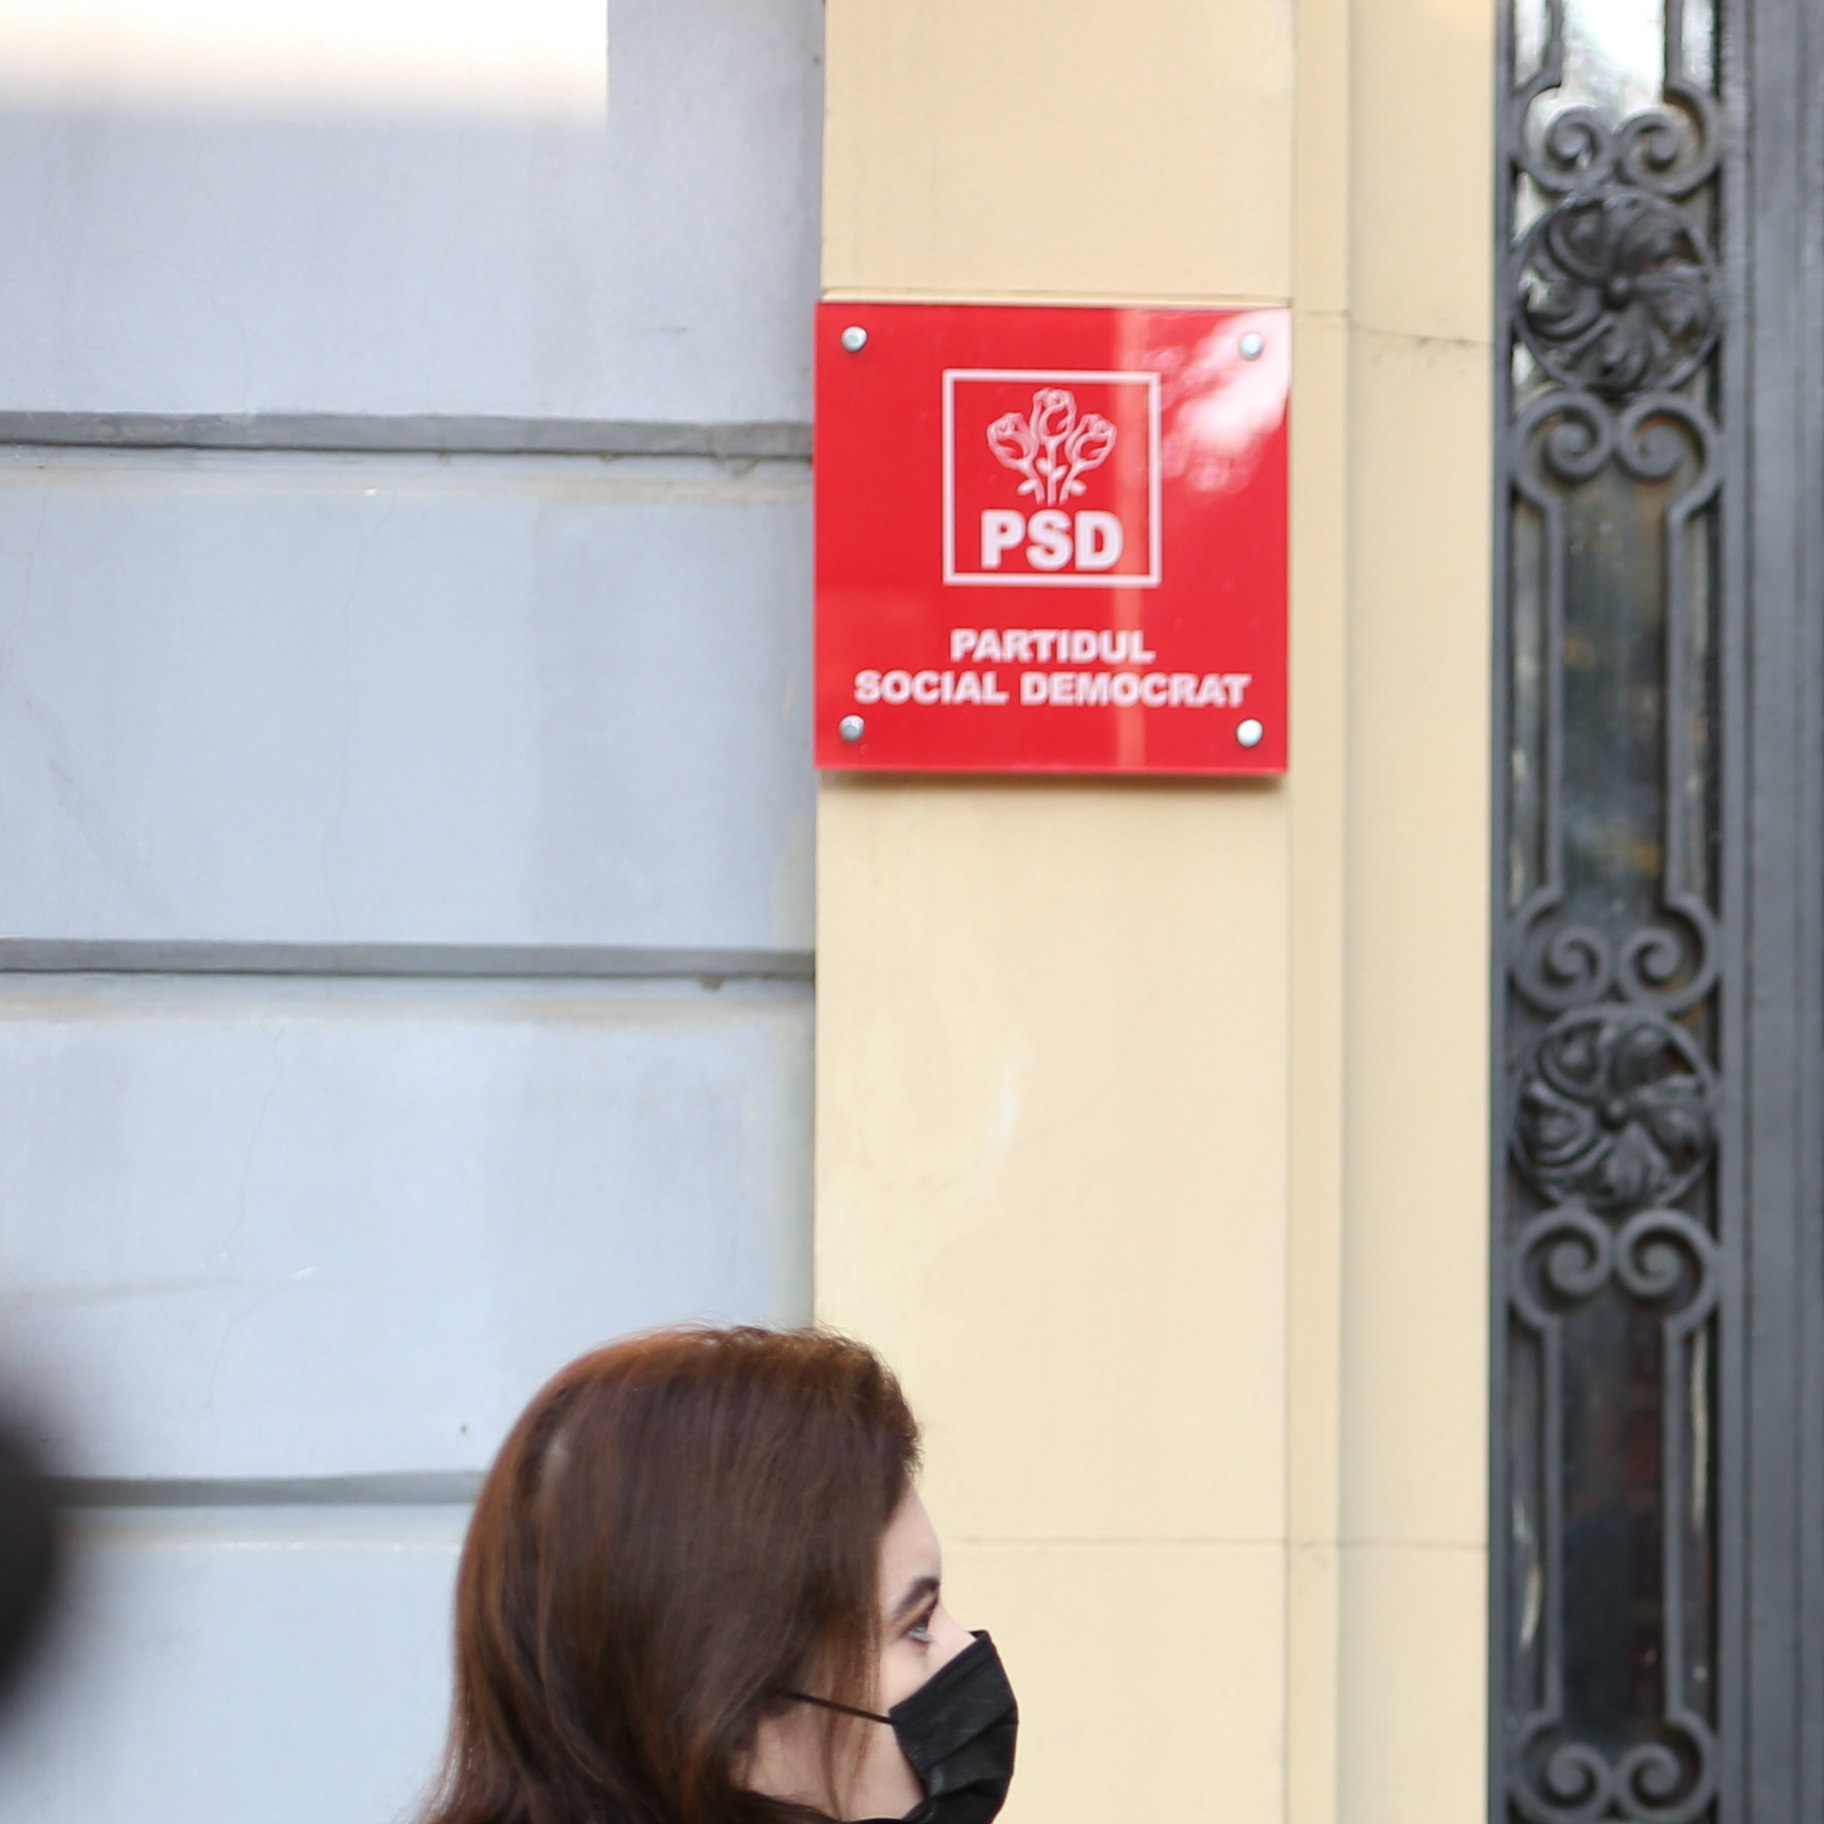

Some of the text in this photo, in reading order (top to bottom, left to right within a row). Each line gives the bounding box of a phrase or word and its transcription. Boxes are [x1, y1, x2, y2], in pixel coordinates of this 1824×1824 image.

[980, 510, 1124, 570] PSD
[950, 629, 1156, 663] PARTIDUL
[853, 670, 1252, 707] SOCIAL DEMOCRAT
